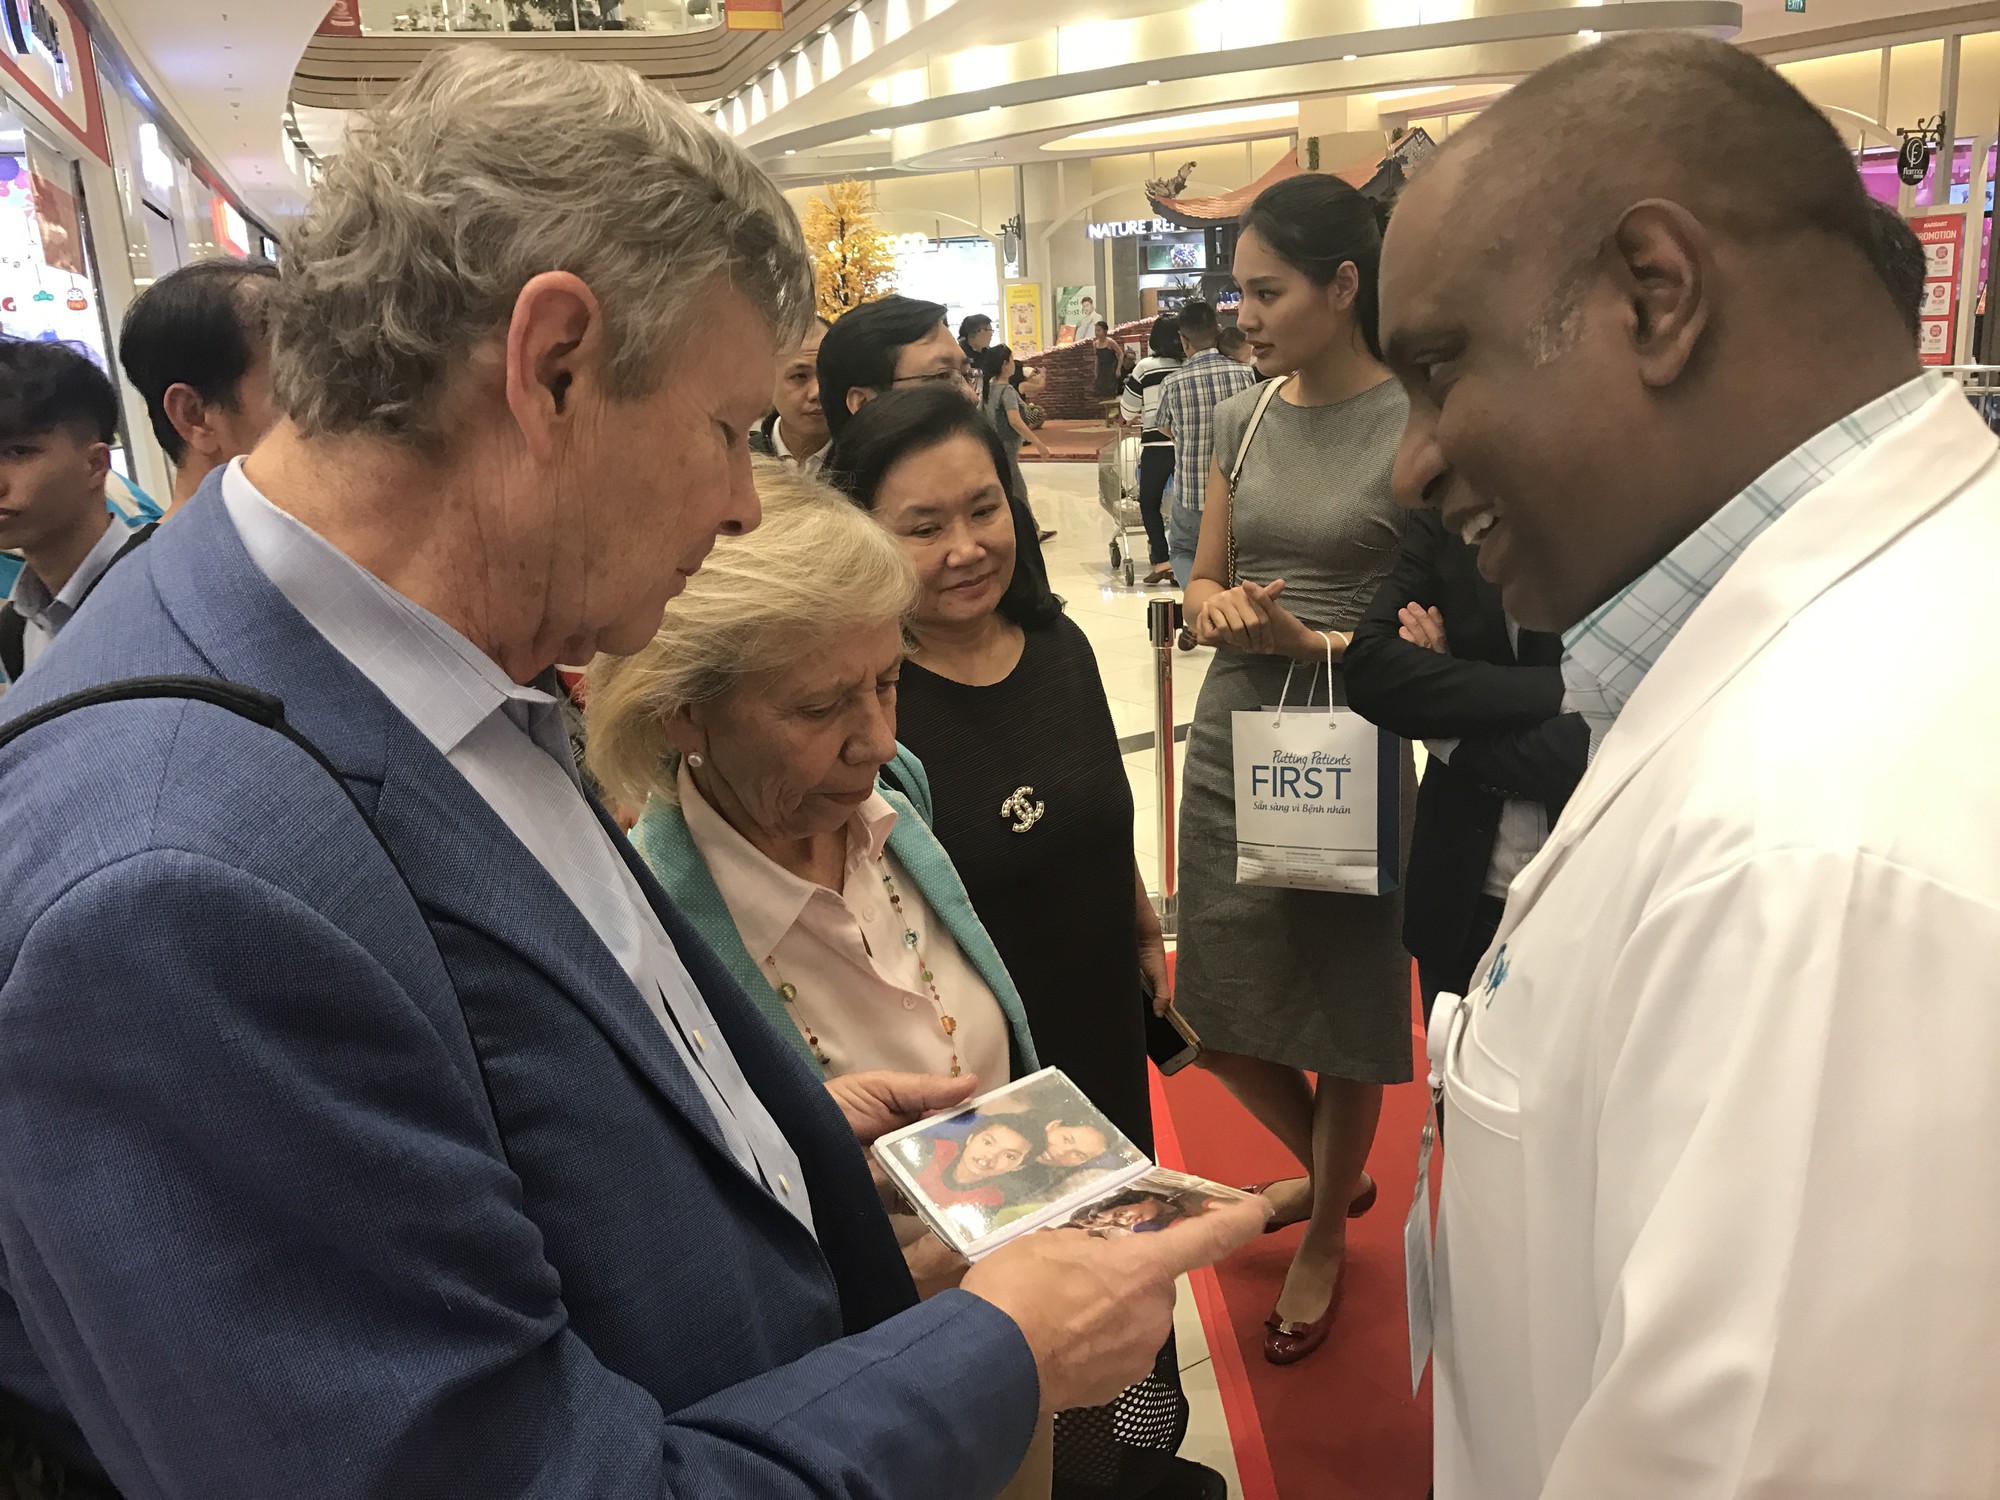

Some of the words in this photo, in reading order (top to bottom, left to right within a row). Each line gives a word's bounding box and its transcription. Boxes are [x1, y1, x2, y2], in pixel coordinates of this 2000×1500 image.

[1088, 220, 1147, 239] NATURE
[1272, 750, 1308, 771] Putting
[1311, 751, 1351, 766] Patients
[1252, 765, 1351, 800] FIRST
[1269, 802, 1290, 813] sàng
[1302, 803, 1324, 814] Bệnh
[1326, 805, 1351, 815] nhân
